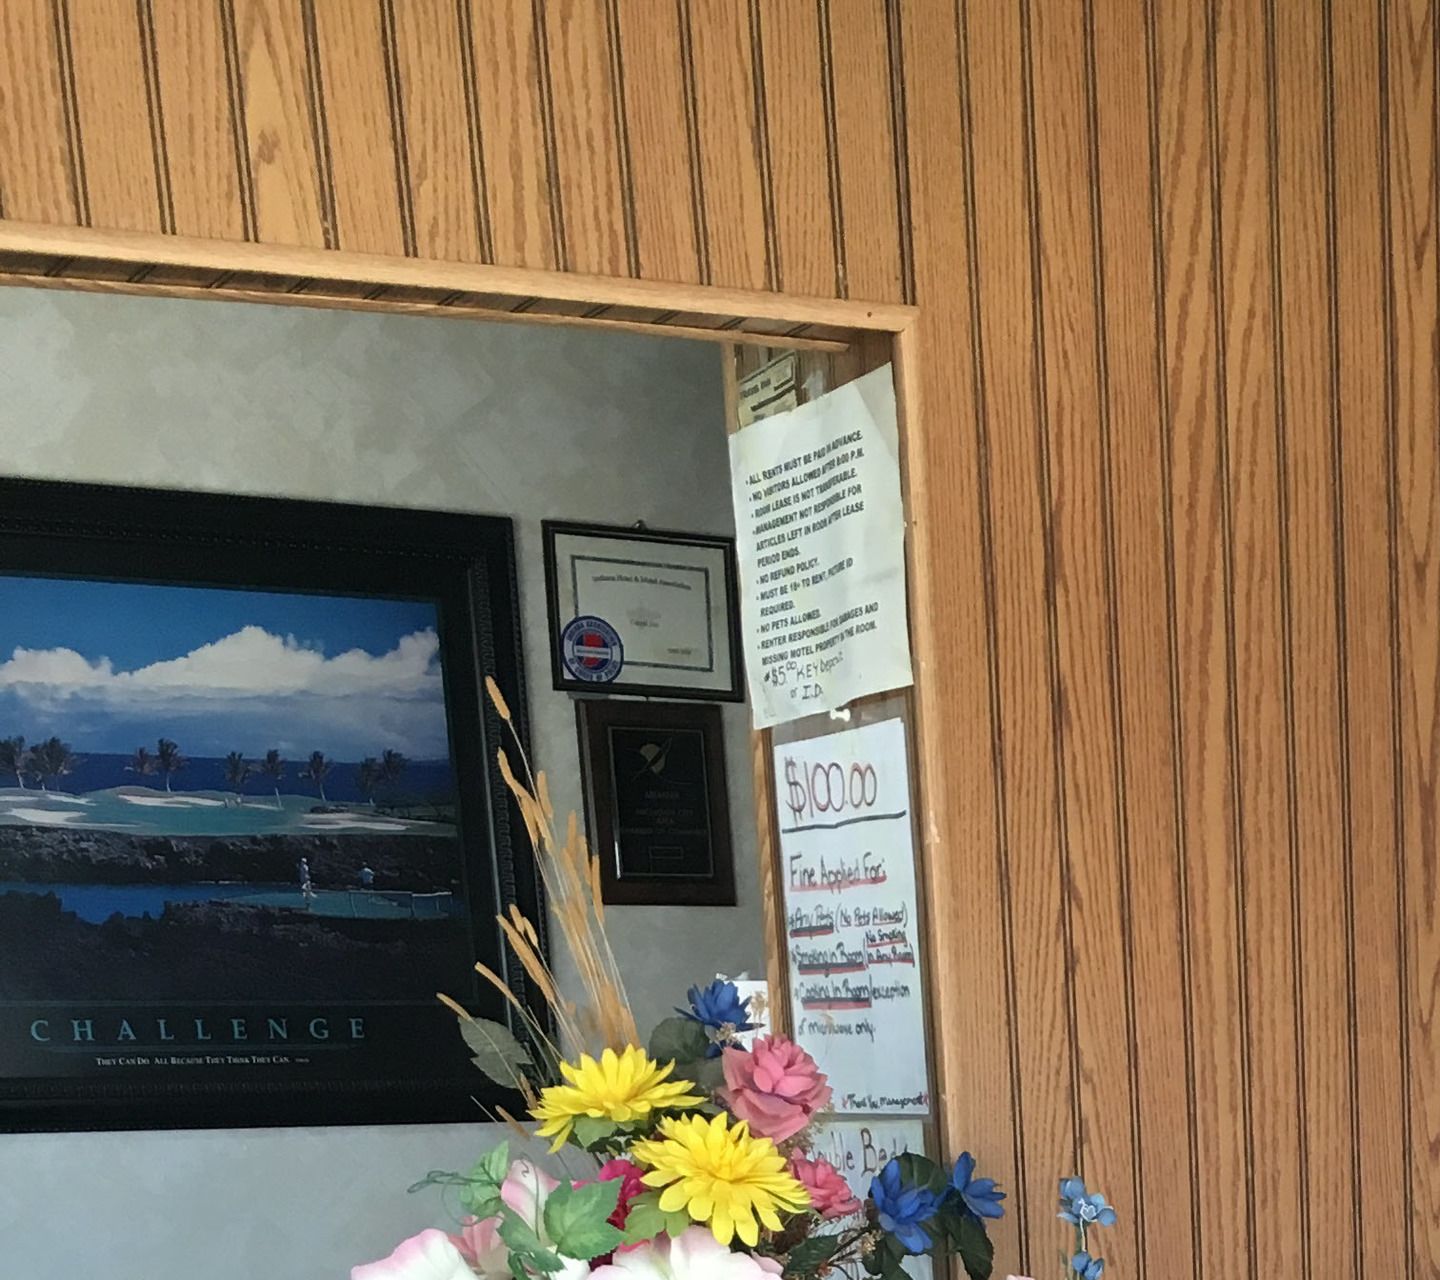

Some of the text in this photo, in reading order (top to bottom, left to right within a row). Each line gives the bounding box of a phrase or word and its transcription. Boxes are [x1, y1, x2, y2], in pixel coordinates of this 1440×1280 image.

[749, 473, 761, 485] ALL
[762, 464, 782, 480] RENTS
[784, 457, 802, 471] MUST
[752, 490, 762, 501] NO
[792, 467, 820, 487] ALLOWED
[756, 512, 797, 535] MANAGEMENT
[799, 506, 812, 520] NOT
[848, 484, 862, 497] FOR
[772, 496, 792, 511] LEASE
[793, 493, 800, 504] IS
[801, 488, 814, 502] NOT
[756, 533, 786, 552] ARTICLES
[787, 527, 802, 541] LEFT
[842, 501, 864, 517] LEASE
[757, 553, 780, 568] PERIOD
[760, 574, 769, 584] NO
[770, 565, 795, 582] REFUND
[760, 587, 779, 601] MUST
[780, 585, 789, 596] BE
[802, 578, 811, 588] TO
[760, 623, 770, 633] NO
[771, 617, 789, 630] PETS
[761, 635, 786, 650] RENTER
[788, 622, 829, 642] RESPONSIBLE
[865, 601, 879, 614] AND
[762, 651, 789, 666] MISSING
[790, 646, 814, 659] MOTEL
[784, 755, 877, 824] $100.00
[790, 854, 816, 888] Fine
[820, 854, 860, 894] Applied
[30, 1017, 366, 1043] CHALLENGE
